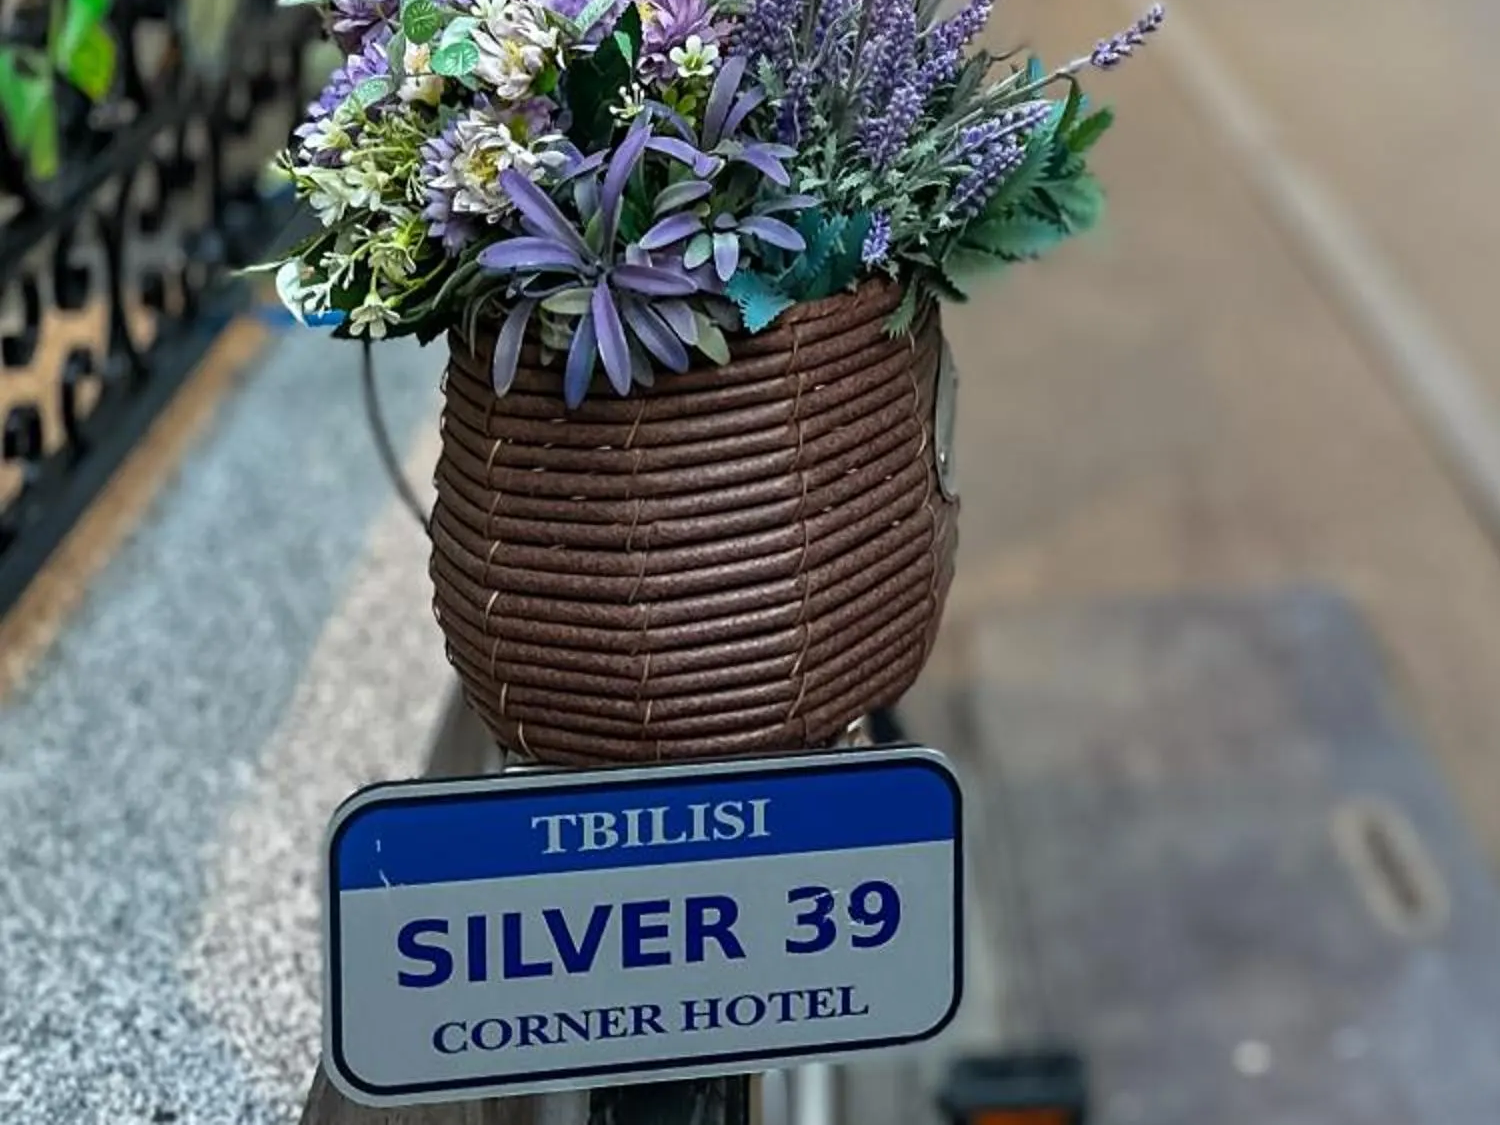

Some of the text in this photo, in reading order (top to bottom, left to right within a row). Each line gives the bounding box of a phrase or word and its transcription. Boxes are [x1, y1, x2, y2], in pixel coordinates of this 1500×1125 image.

[531, 799, 771, 855] TBILISI
[396, 880, 901, 988] SILVER 39
[432, 985, 870, 1055] CORNER HOTEL
